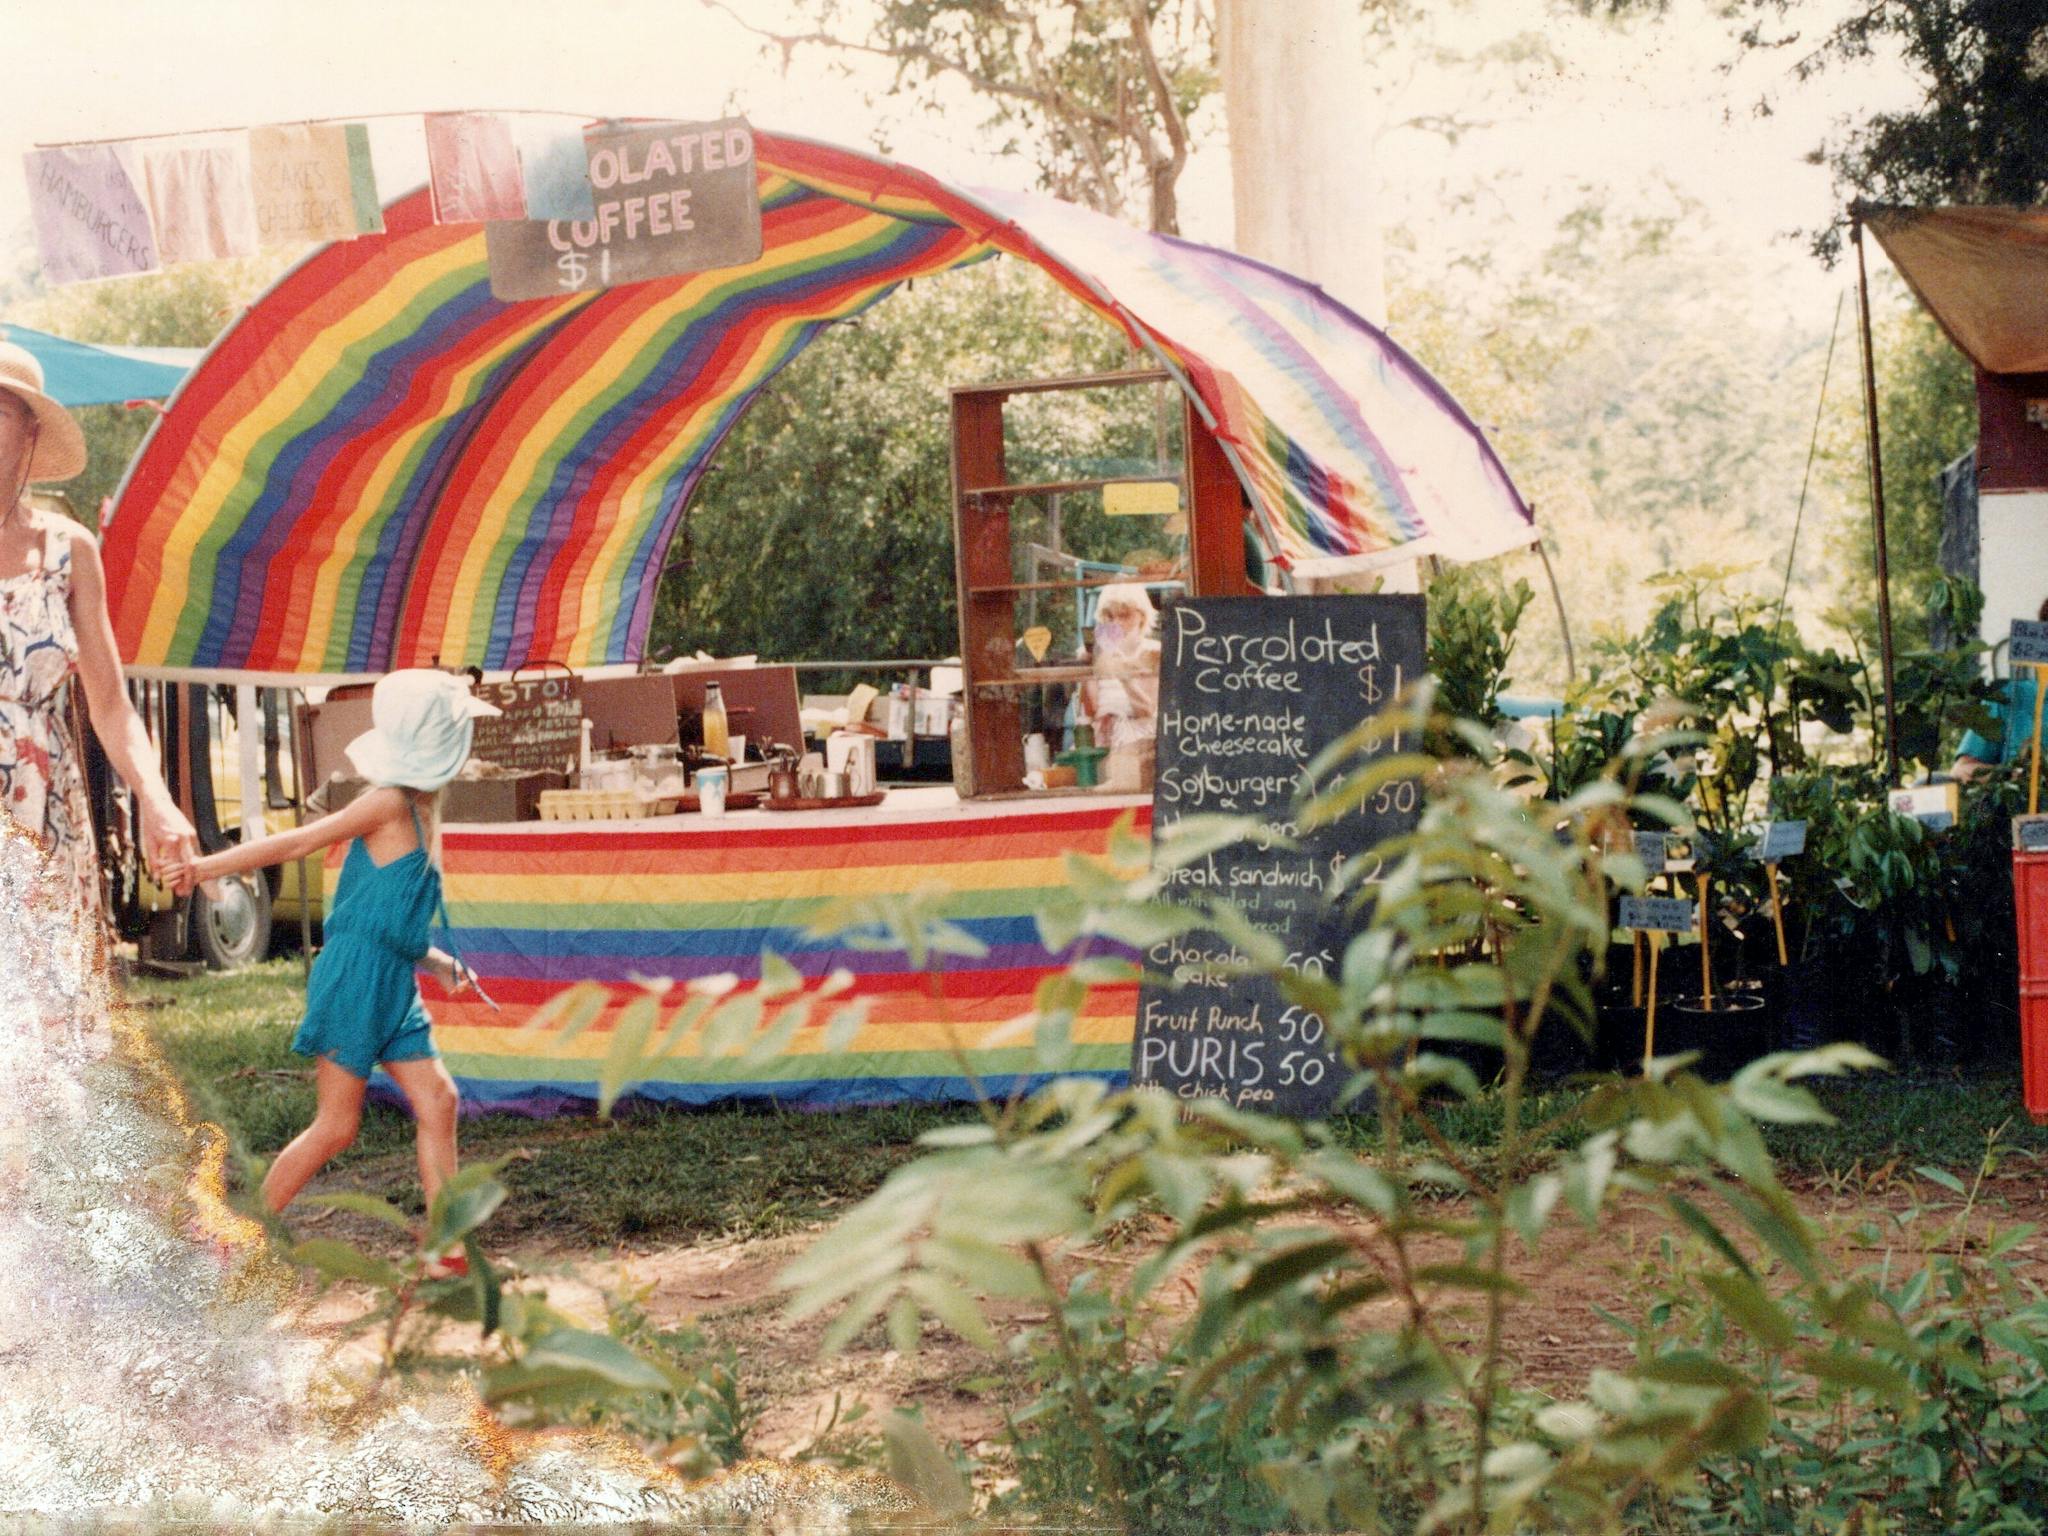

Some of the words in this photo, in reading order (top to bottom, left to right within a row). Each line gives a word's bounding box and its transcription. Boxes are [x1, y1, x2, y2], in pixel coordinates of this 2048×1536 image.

[589, 127, 754, 190] OLATED
[548, 189, 696, 251] COFFEE
[476, 679, 570, 705] ESTO!
[1195, 661, 1303, 693] Coffee
[1179, 731, 1309, 760] Cheesecake
[1149, 938, 1250, 968] Chocola
[1144, 1000, 1199, 1035] Fruit
[1206, 1003, 1264, 1035] Punch
[1141, 1036, 1267, 1087] PURIS
